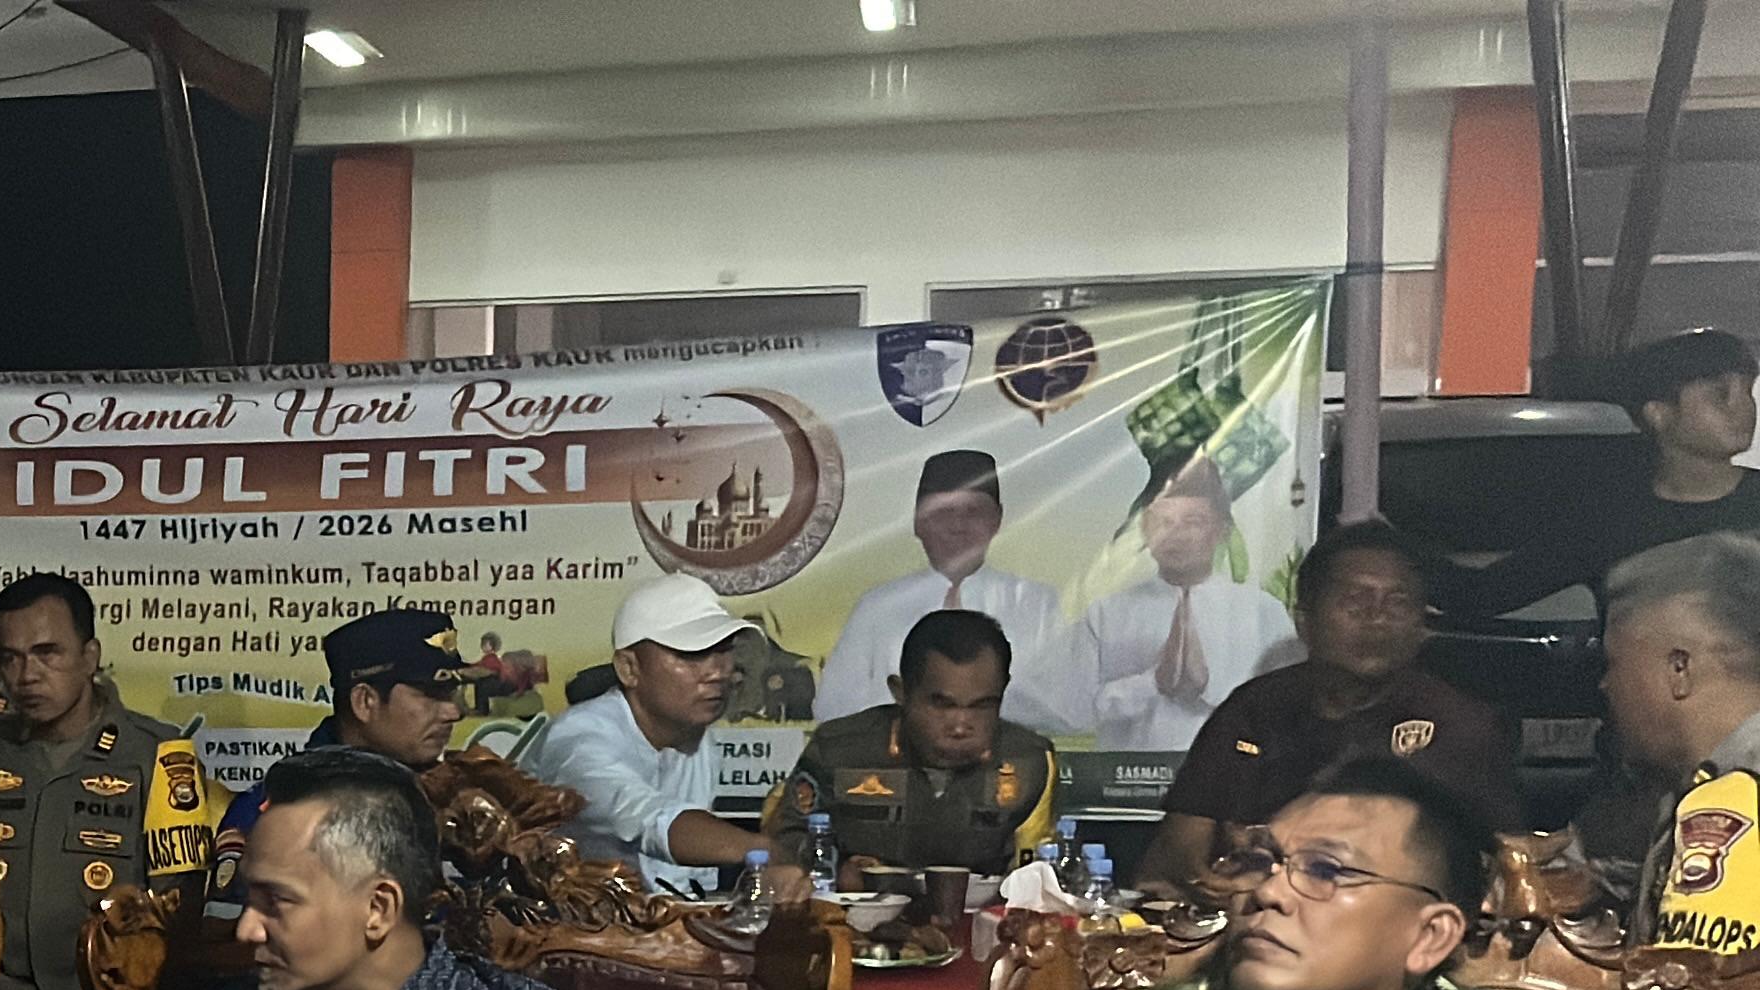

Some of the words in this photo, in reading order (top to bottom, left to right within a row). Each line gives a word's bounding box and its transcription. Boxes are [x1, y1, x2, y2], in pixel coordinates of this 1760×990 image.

[623, 336, 804, 362] mengucapkan
[9, 391, 258, 445] Selamat
[274, 387, 417, 438] Hari
[451, 379, 612, 438] Raya
[16, 457, 268, 506] IDUL
[320, 444, 587, 499] FITRI
[80, 519, 146, 541] 1447
[292, 516, 305, 541] /
[318, 514, 393, 536] 2026
[407, 509, 528, 535] Masehi
[210, 563, 351, 588] waminkum,
[362, 559, 479, 588] Taqabbal
[490, 562, 534, 587] yaa
[97, 598, 131, 625] rgi
[142, 597, 257, 624] Melayani,
[269, 596, 376, 623] Rayakan
[388, 595, 555, 621] Kemenangan
[132, 631, 221, 658] dengan
[232, 630, 280, 653] Hati
[290, 635, 326, 657] ya
[173, 673, 223, 695] Tips
[233, 672, 305, 700] Mudik
[205, 741, 297, 758] PASTIKAN
[715, 742, 772, 758] RASI
[719, 769, 786, 786] LELAH
